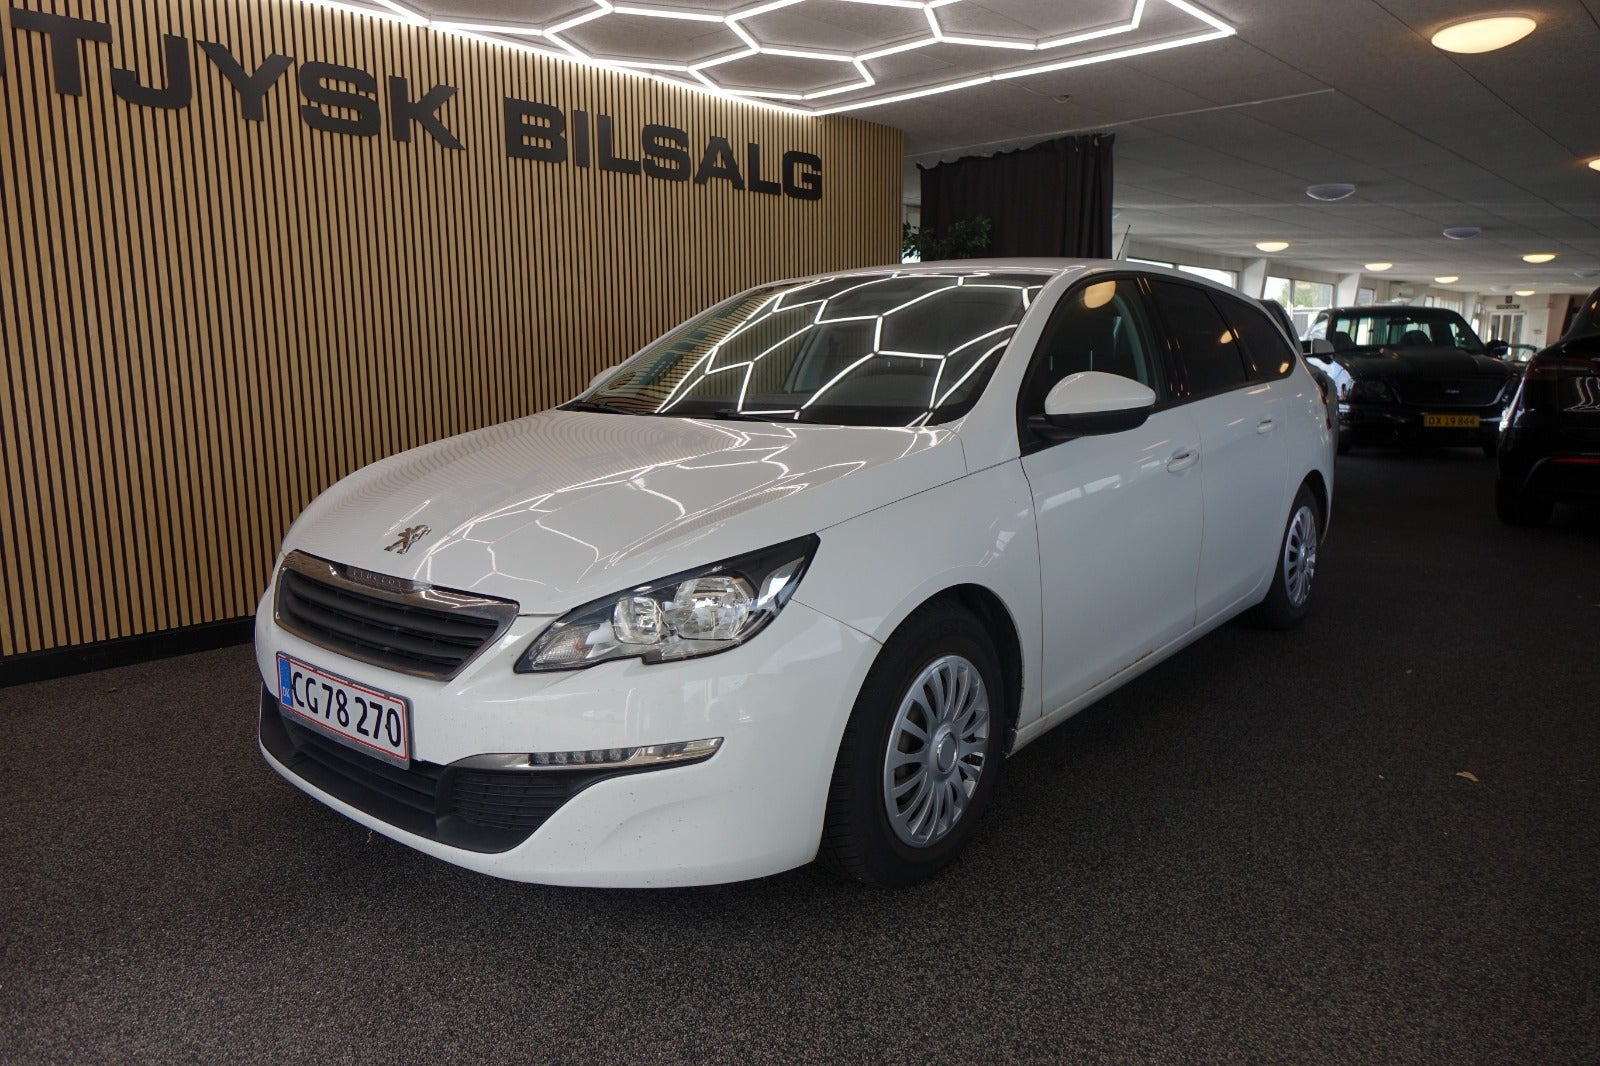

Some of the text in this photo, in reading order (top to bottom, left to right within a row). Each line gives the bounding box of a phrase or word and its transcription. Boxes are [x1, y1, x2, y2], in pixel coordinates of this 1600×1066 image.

[0, 8, 823, 201] TJYSK BILSALG
[282, 687, 291, 698] DK
[292, 671, 402, 748] CG 78 270
